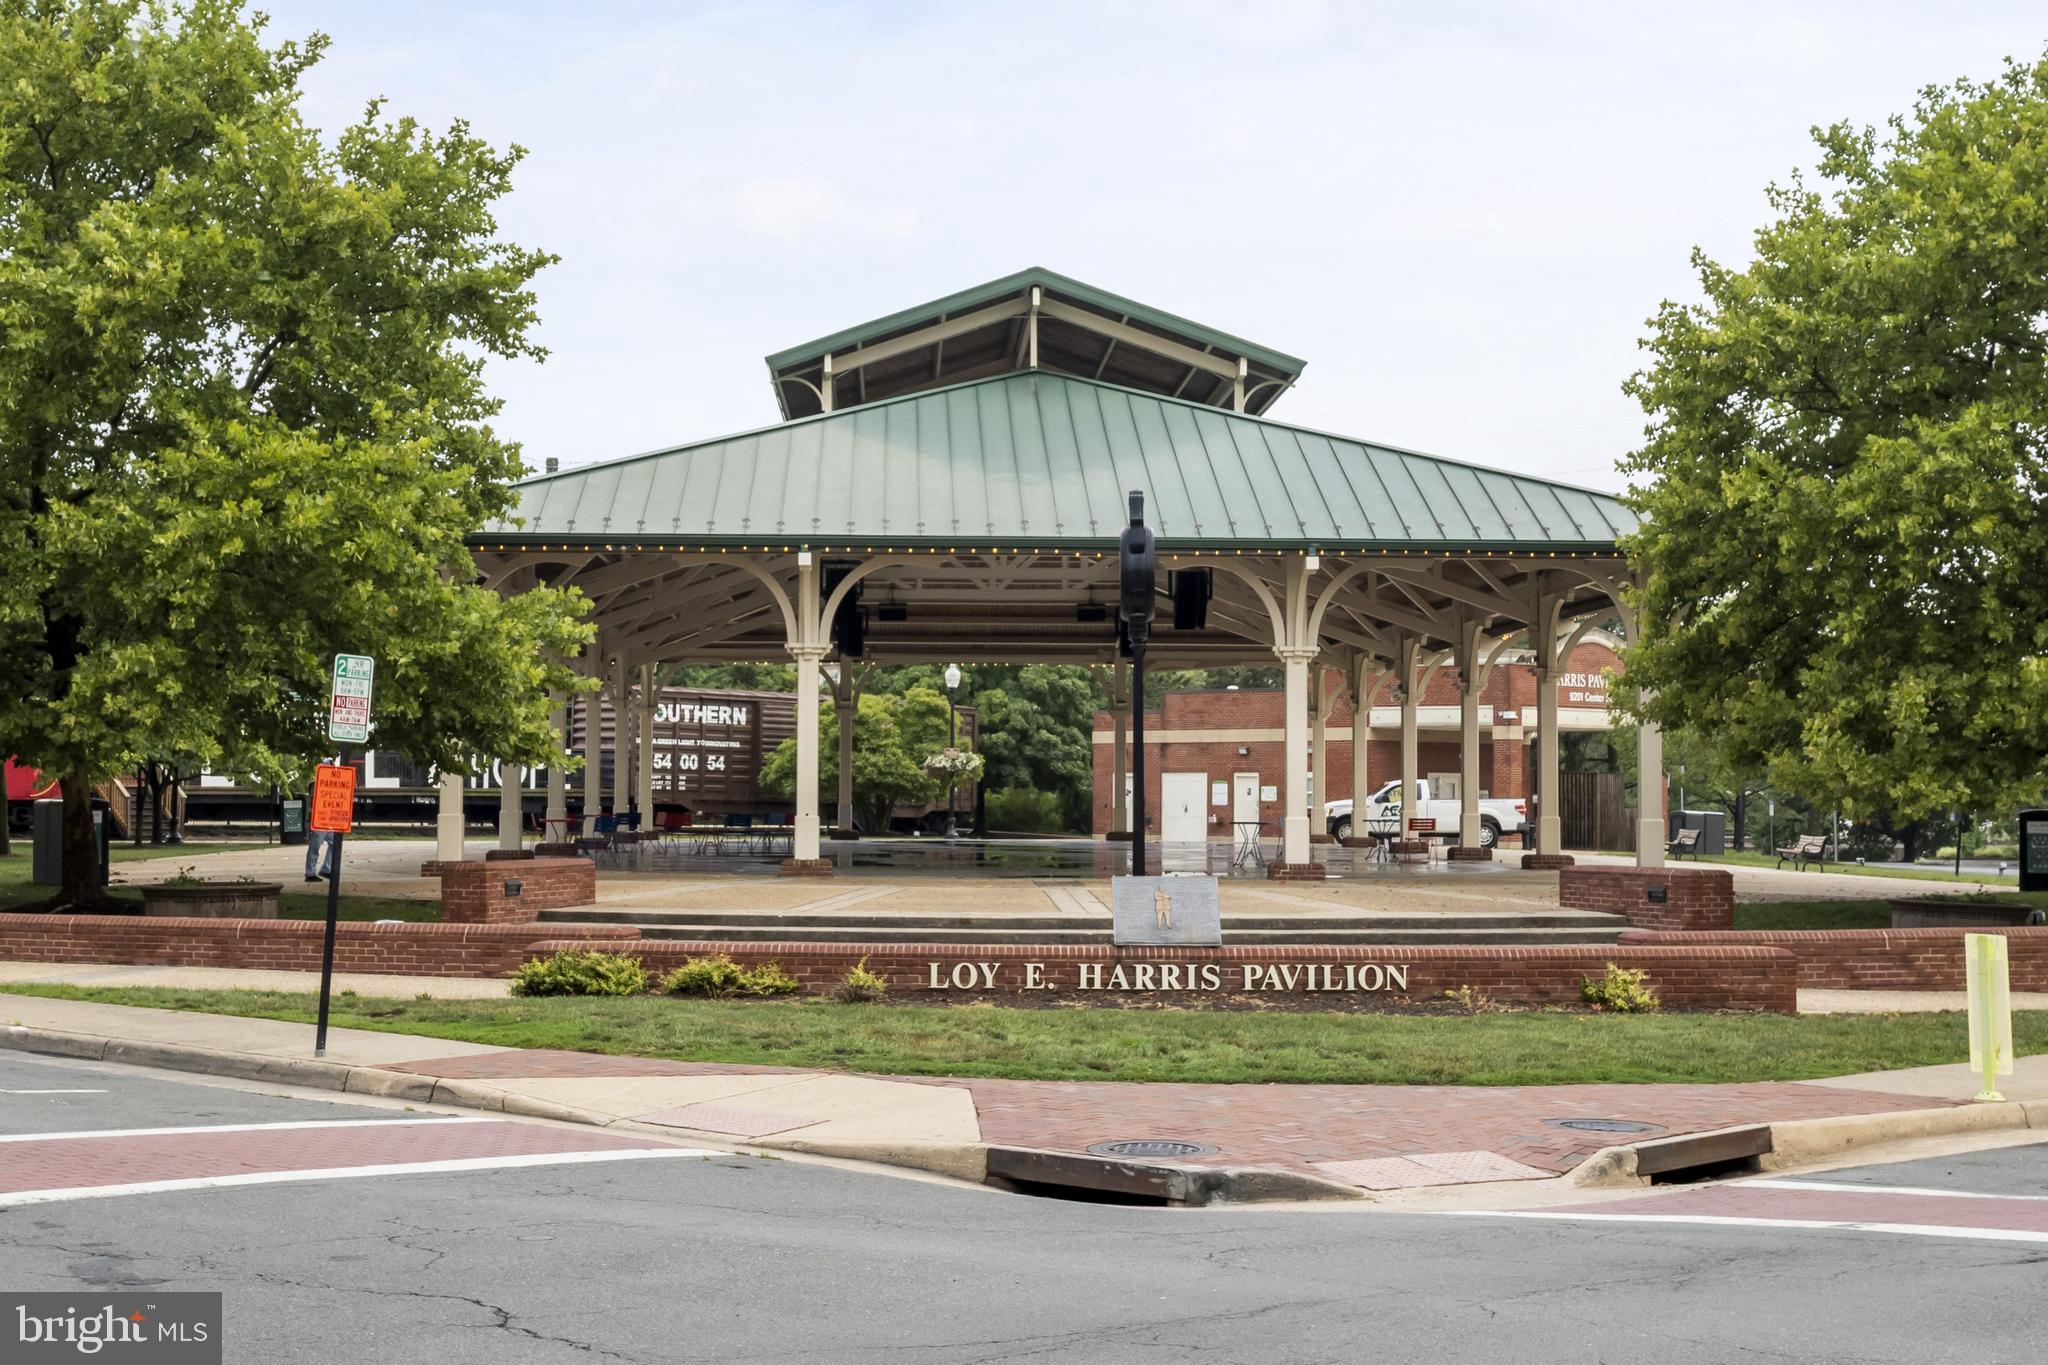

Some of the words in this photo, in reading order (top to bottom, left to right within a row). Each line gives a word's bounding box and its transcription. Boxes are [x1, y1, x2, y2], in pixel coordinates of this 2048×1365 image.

[338, 659, 346, 675] 2
[347, 668, 370, 678] PARKING
[1557, 673, 1586, 687] ARRIS
[336, 696, 345, 707] NO
[347, 698, 365, 708] PARKING
[653, 703, 747, 726] OUTHERN
[653, 753, 672, 769] 54
[680, 754, 698, 770] 00
[707, 755, 725, 771] 54
[331, 770, 341, 779] NO
[320, 779, 350, 790] PARKING
[320, 790, 348, 801] SPECIAL
[322, 801, 344, 809] EVENT
[928, 963, 1001, 989] LOY
[1024, 963, 1056, 990] E.
[1077, 963, 1222, 991] HARRIS
[1241, 964, 1410, 992] PAVILION
